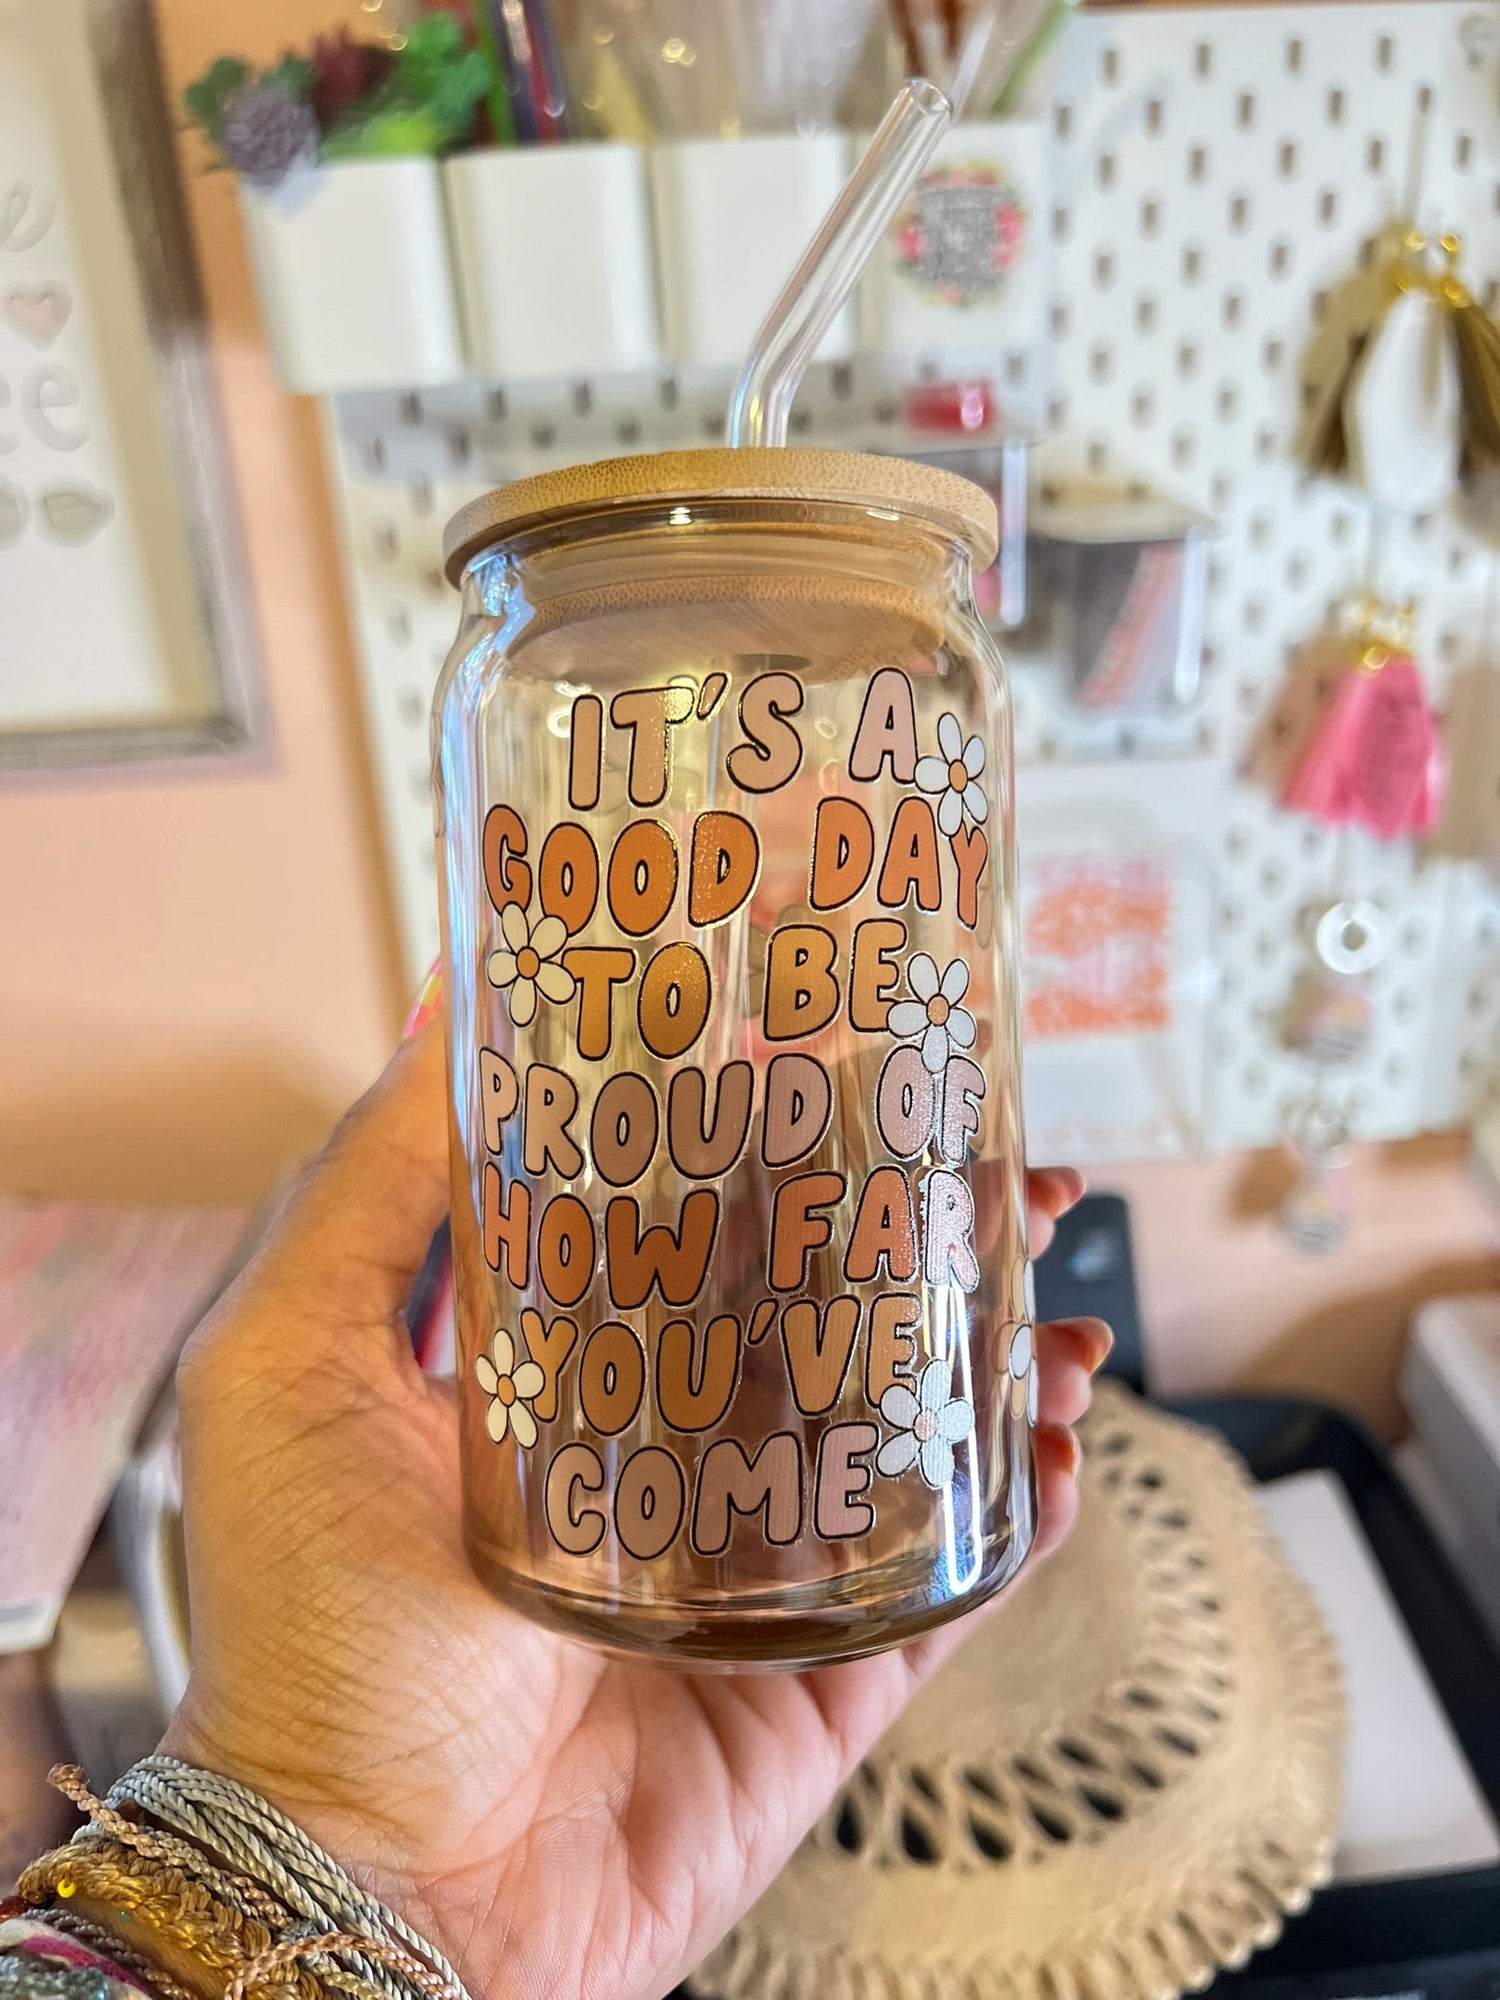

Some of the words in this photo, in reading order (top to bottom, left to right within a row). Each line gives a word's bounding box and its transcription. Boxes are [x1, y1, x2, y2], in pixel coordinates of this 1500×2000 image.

[568, 673, 804, 810] IT'S
[848, 667, 917, 784] A
[483, 804, 760, 938] GOOD
[809, 797, 988, 929] DAY
[562, 941, 712, 1060] TO
[763, 918, 909, 1042] BE
[479, 1048, 832, 1188] PROUD
[877, 1046, 986, 1167] OF
[483, 1162, 720, 1310] HOW
[768, 1165, 979, 1293] FAR
[521, 1293, 922, 1436] YOU'VE
[545, 1421, 881, 1560] COME
